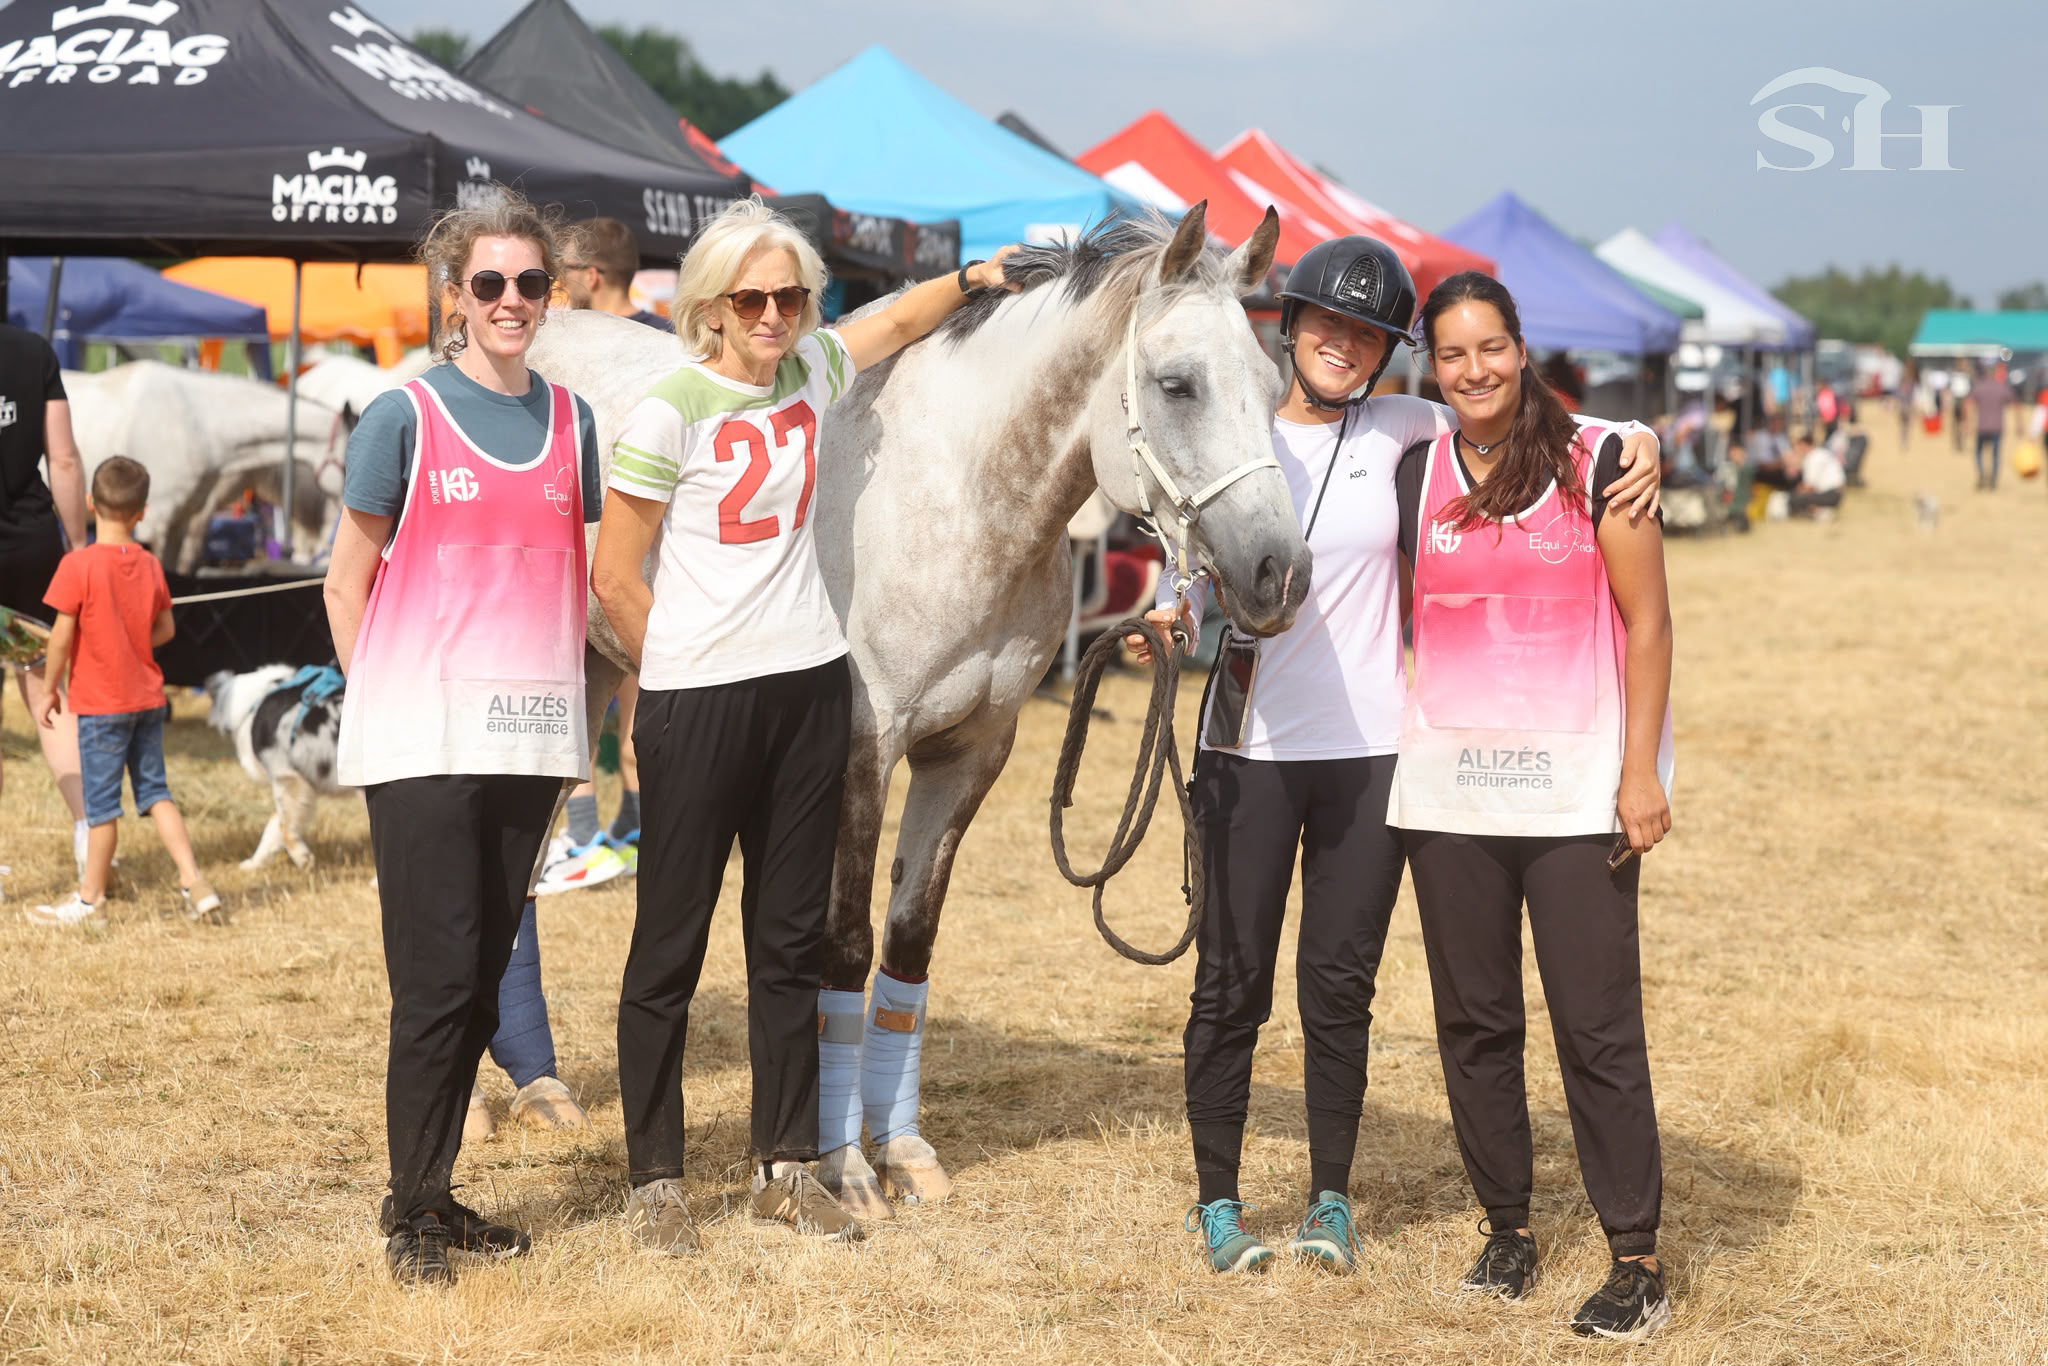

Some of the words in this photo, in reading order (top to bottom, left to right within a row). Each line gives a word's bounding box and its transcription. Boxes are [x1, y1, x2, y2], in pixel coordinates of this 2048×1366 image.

[272, 174, 398, 206] MACIAG
[272, 204, 398, 224] OFFROAD
[713, 400, 817, 545] 27
[1529, 532, 1560, 551] Equi
[487, 692, 568, 718] ALIZÉS
[486, 718, 568, 735] endurance
[1457, 745, 1552, 772] ALIZÉS
[1456, 772, 1553, 790] endurance
